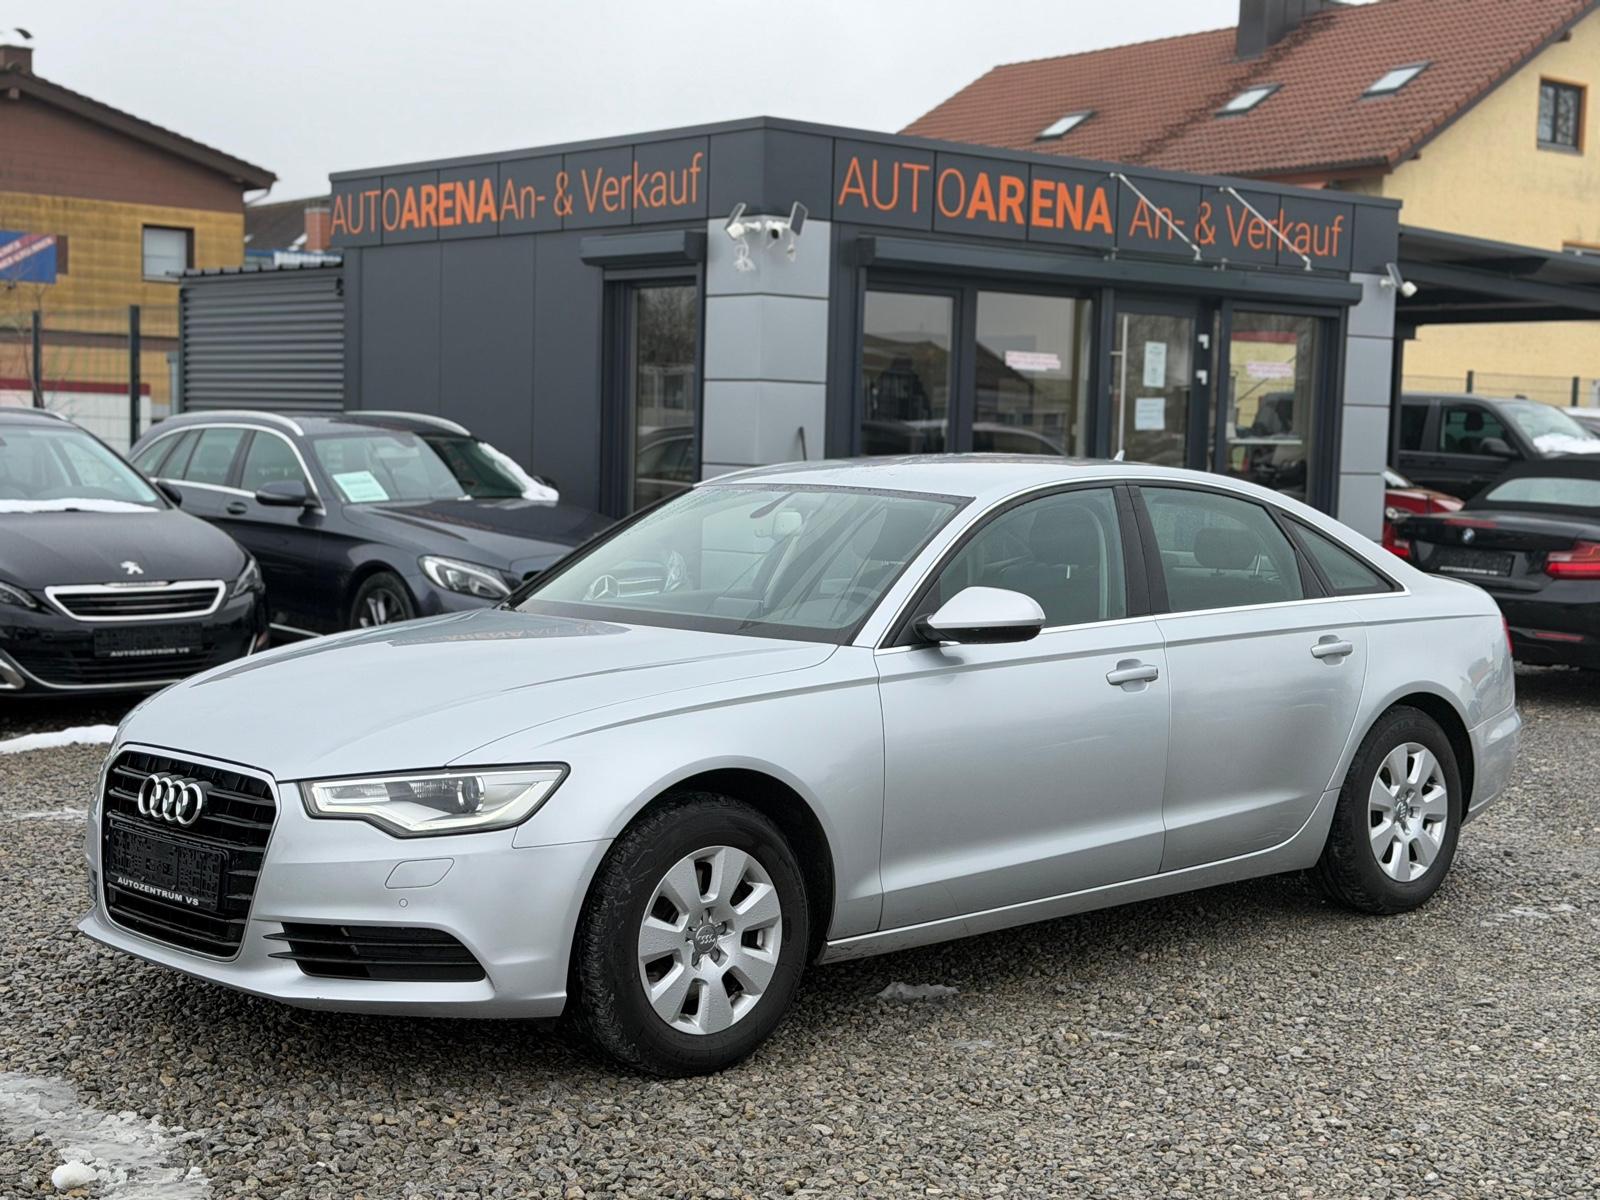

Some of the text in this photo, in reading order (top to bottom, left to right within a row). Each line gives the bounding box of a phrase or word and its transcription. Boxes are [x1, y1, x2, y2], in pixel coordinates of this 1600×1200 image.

[331, 152, 703, 235] AUTOARENA An- & Verkauf
[838, 157, 1344, 257] AUTOARENA An- & Verkauf
[117, 877, 199, 906] AUTOZENTRUM VS
